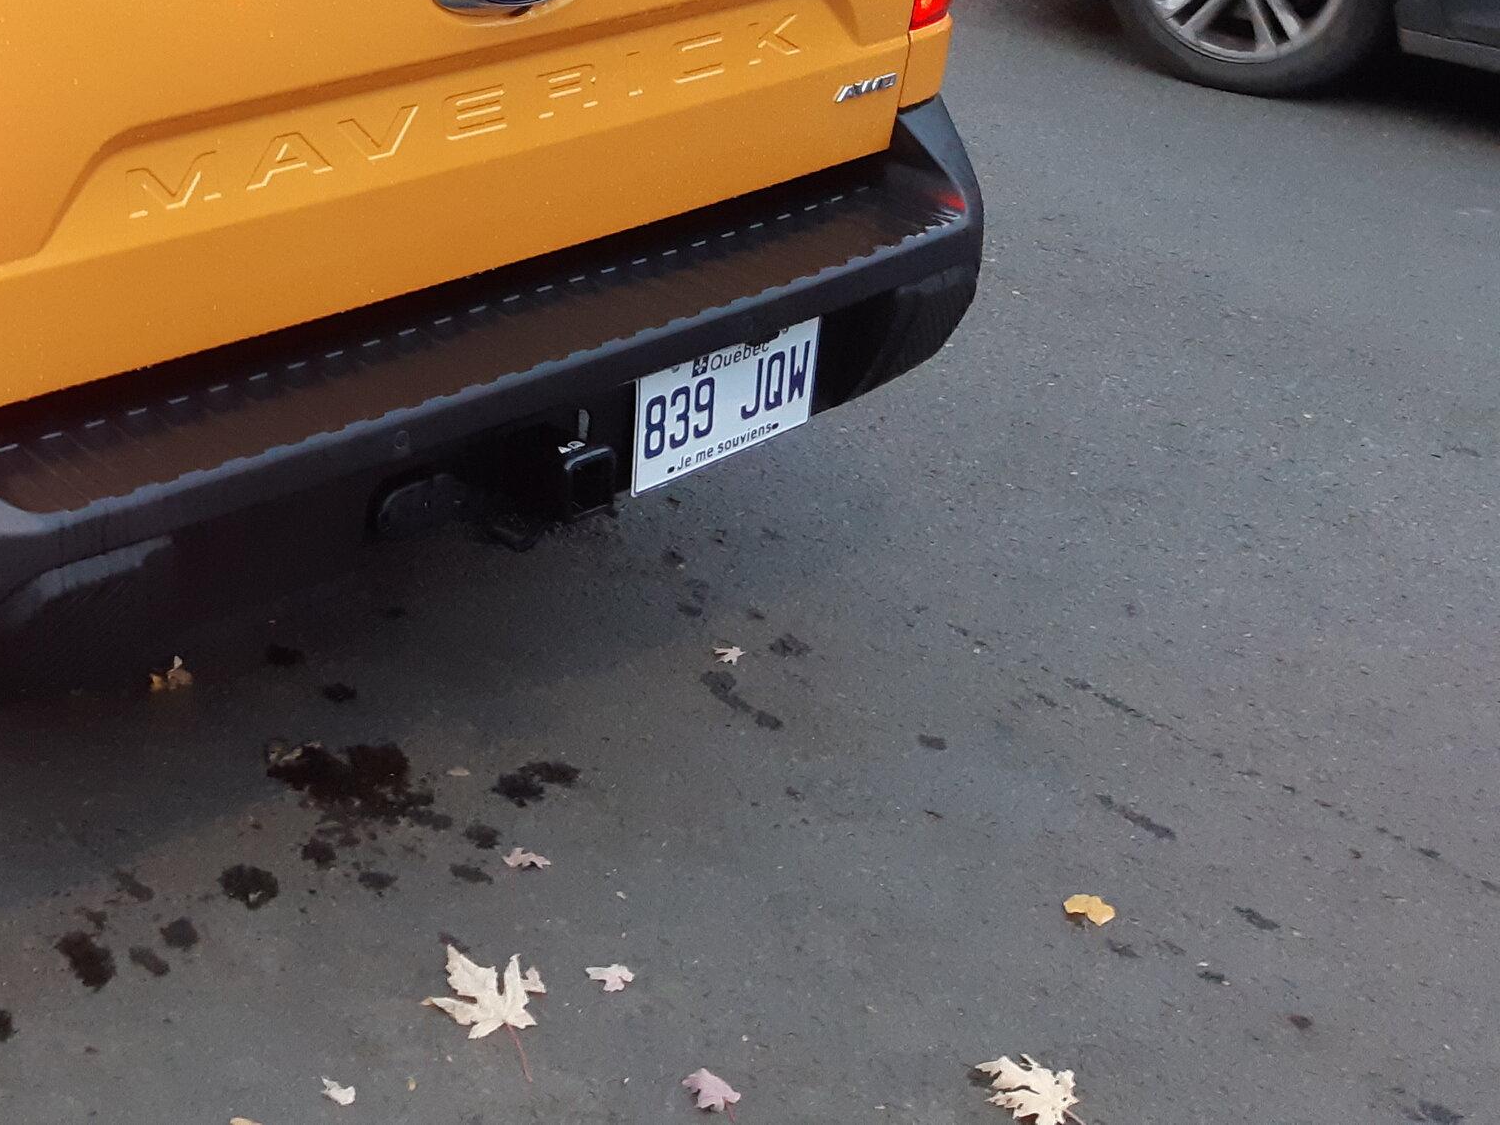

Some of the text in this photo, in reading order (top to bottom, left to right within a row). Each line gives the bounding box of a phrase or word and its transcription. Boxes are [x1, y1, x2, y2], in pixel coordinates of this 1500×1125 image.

[126, 14, 802, 219] MAVERICK
[710, 342, 769, 371] Québec
[644, 340, 811, 459] 839 JQW
[677, 422, 773, 470] Je me souviens
